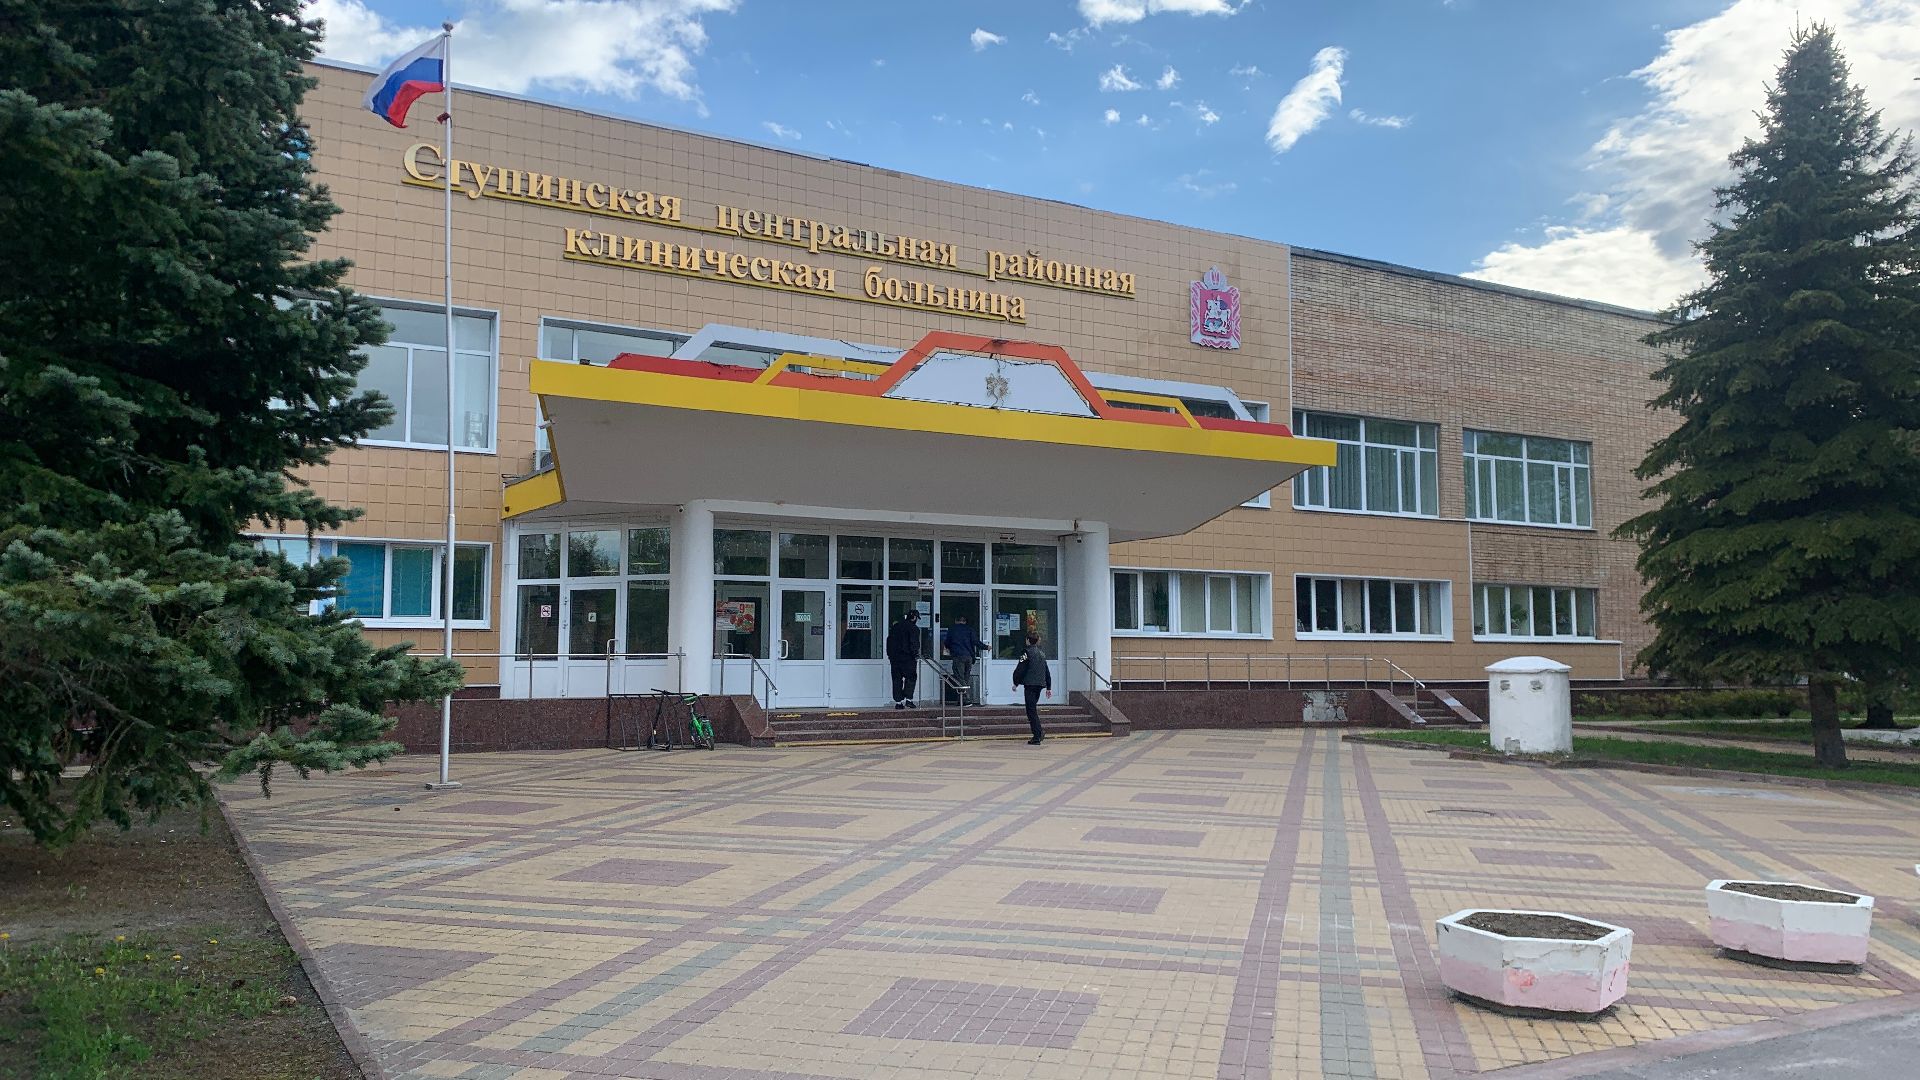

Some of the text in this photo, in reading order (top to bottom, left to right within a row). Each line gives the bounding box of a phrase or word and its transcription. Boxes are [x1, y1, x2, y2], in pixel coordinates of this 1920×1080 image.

[403, 142, 1136, 295] Ступинская центральная районная
[564, 226, 1026, 322] клиническая больница
